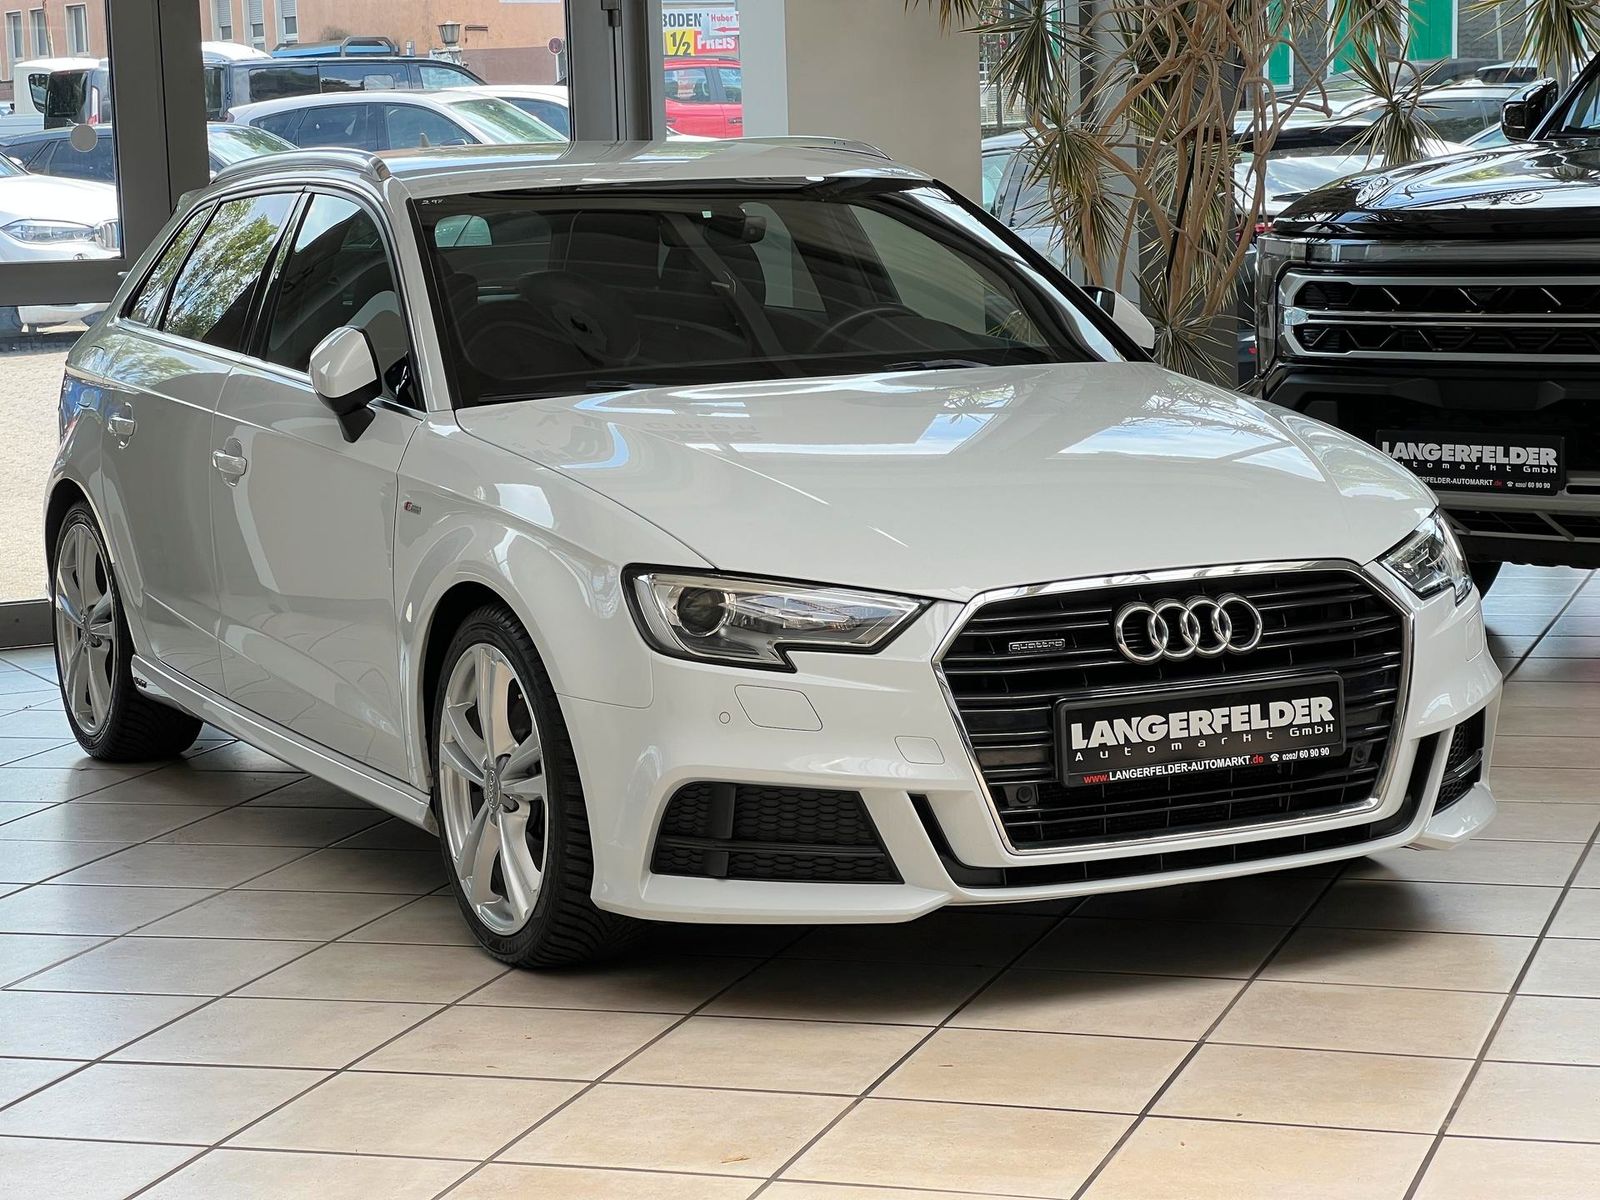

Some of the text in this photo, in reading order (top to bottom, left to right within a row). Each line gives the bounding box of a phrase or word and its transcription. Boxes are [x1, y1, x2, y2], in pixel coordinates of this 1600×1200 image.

[1382, 441, 1558, 466] LANGERFELDER
[1400, 461, 1557, 474] tomarkt GmbH
[1011, 641, 1063, 651] quattro
[1071, 696, 1335, 750] LANGERFELDER
[1075, 723, 1334, 762] Automarkt GmbH
[1083, 754, 1264, 784] www.LANGERFELDER-AUTOMARKT.de
[1299, 749, 1309, 759] 60
[1310, 748, 1320, 758] 90
[1320, 747, 1330, 757] 90
